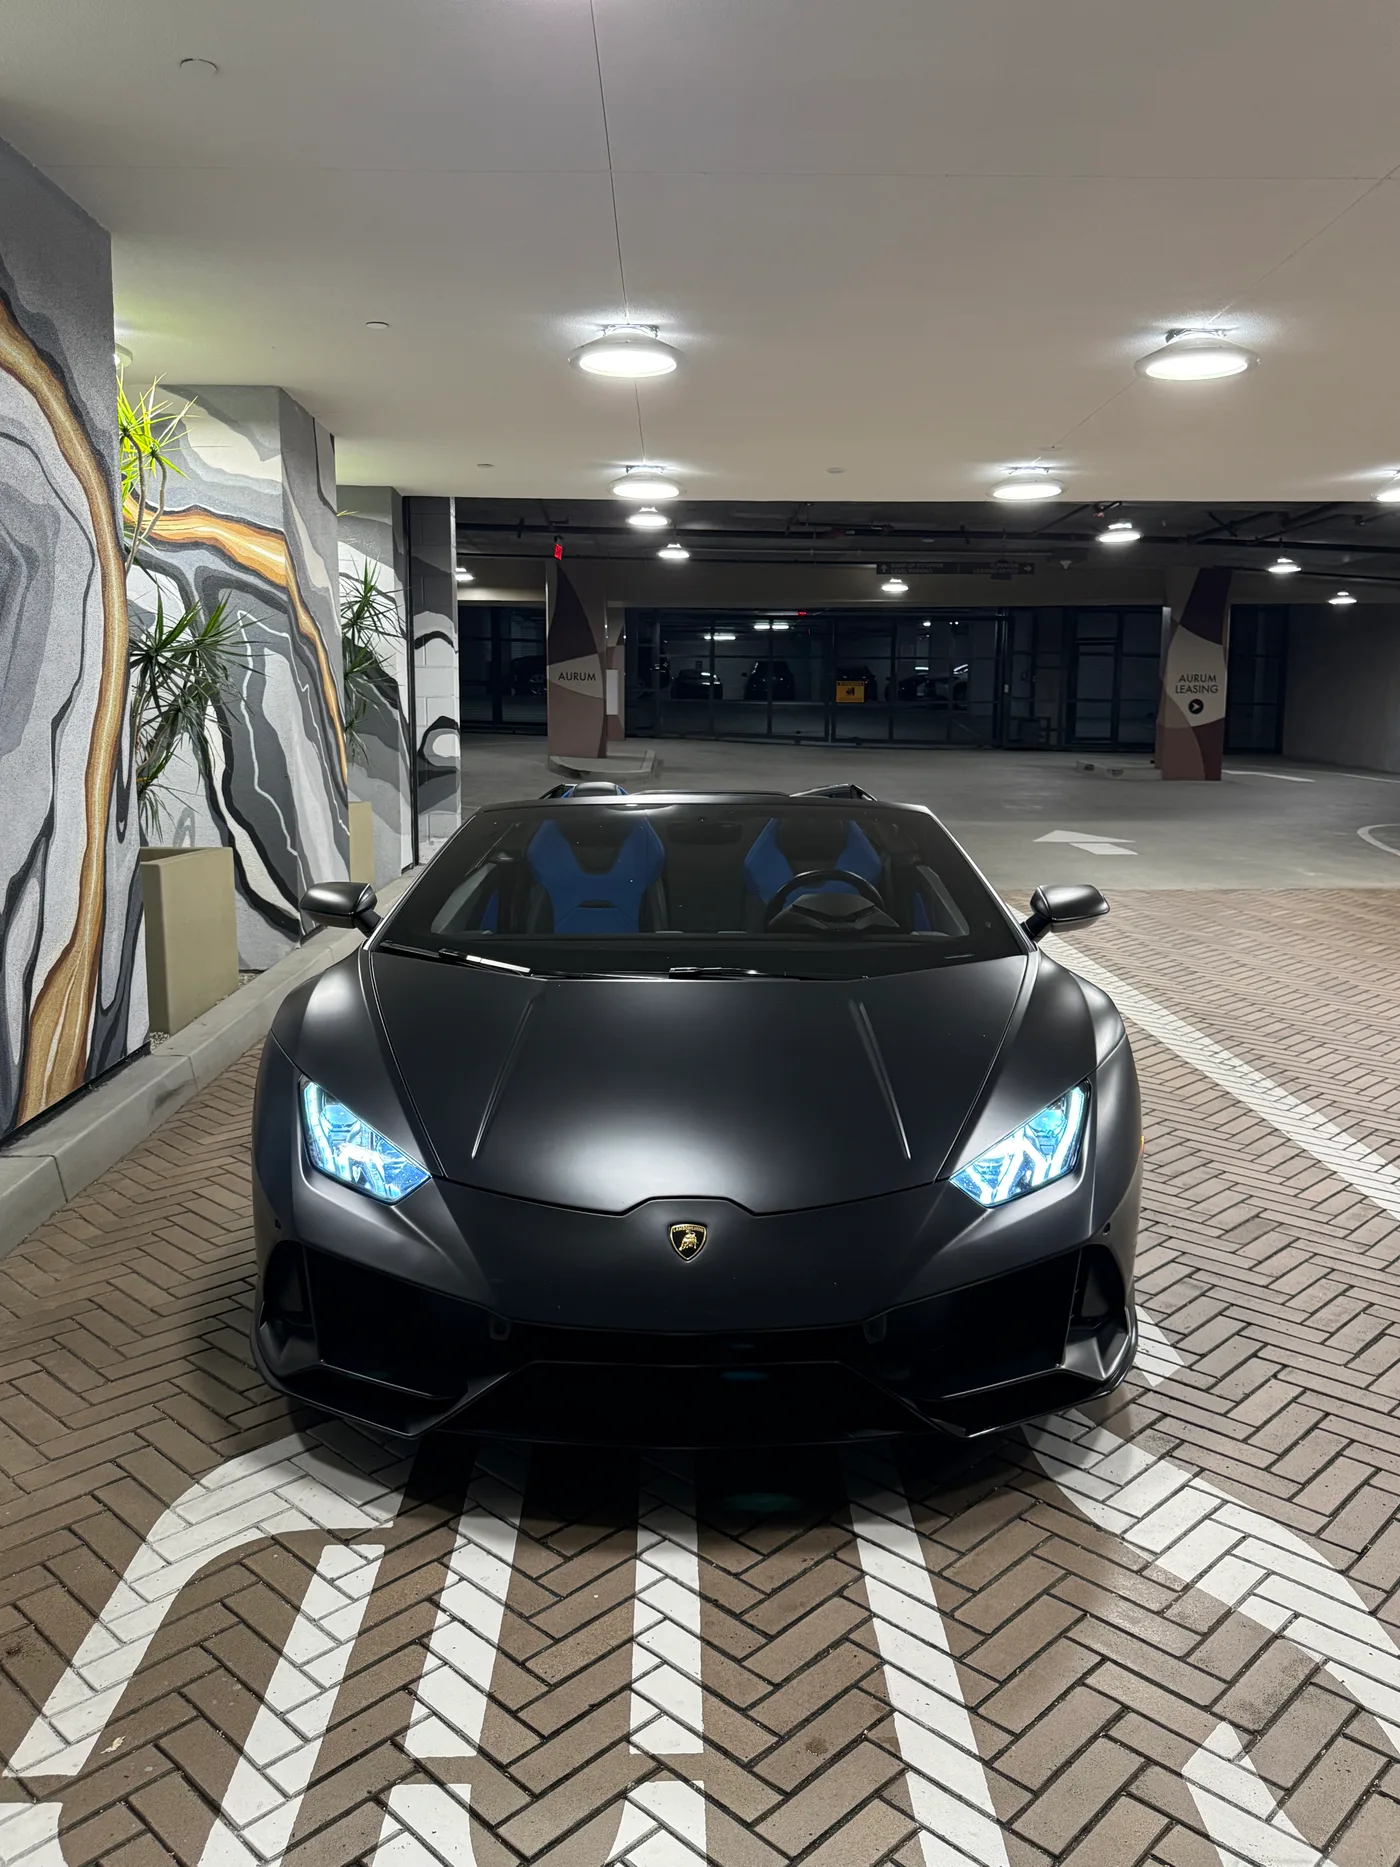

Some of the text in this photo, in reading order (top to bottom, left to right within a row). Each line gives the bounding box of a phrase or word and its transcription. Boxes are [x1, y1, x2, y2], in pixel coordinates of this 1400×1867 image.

[558, 672, 596, 681] AURUM
[1179, 673, 1217, 683] AURUM
[1175, 684, 1219, 694] LEASING
